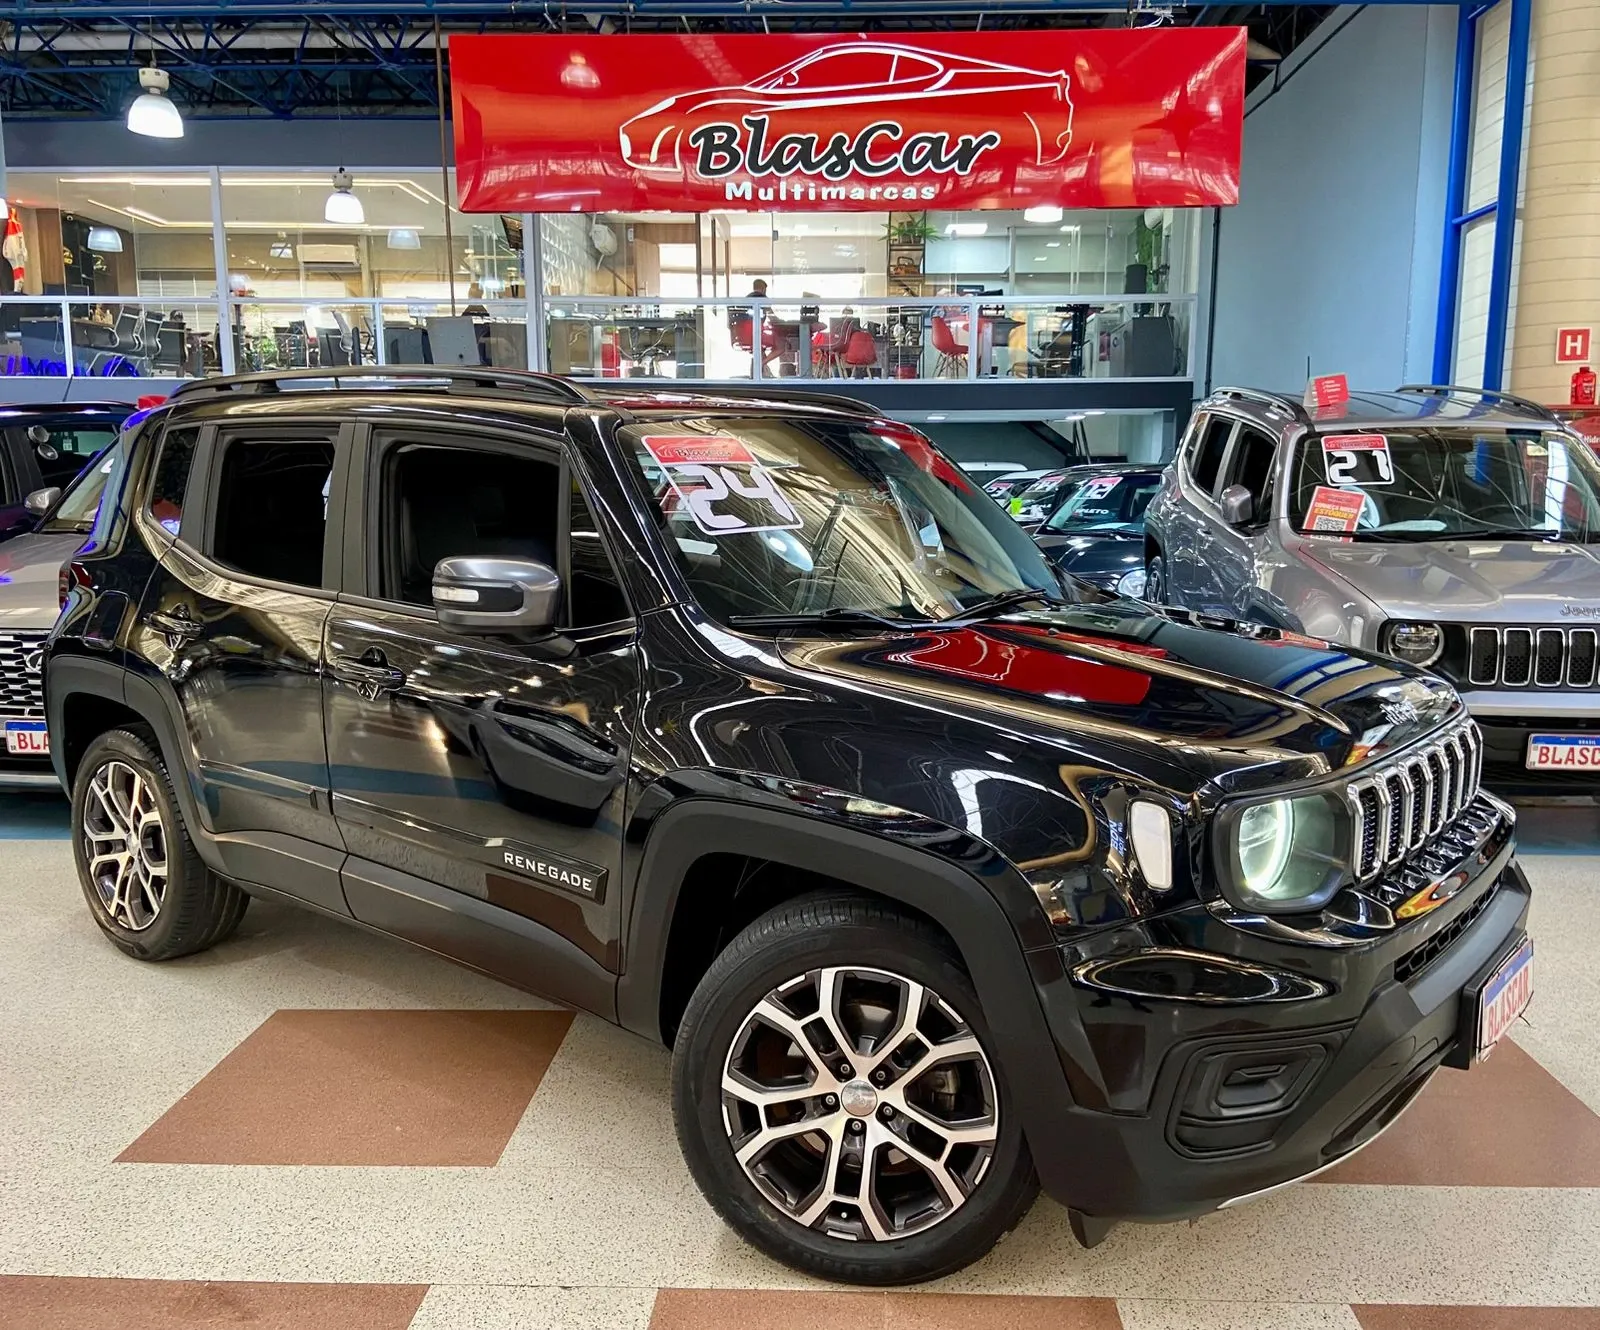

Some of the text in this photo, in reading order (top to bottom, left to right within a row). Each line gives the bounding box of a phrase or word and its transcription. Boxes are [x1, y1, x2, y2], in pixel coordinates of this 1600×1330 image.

[690, 115, 1000, 180] BlasCar
[725, 182, 936, 201] Multimarcas
[1565, 335, 1582, 356] H
[1329, 450, 1390, 482] 21
[673, 464, 794, 529] 24
[1538, 746, 1600, 765] BLASC
[504, 852, 592, 891] RENEGADE
